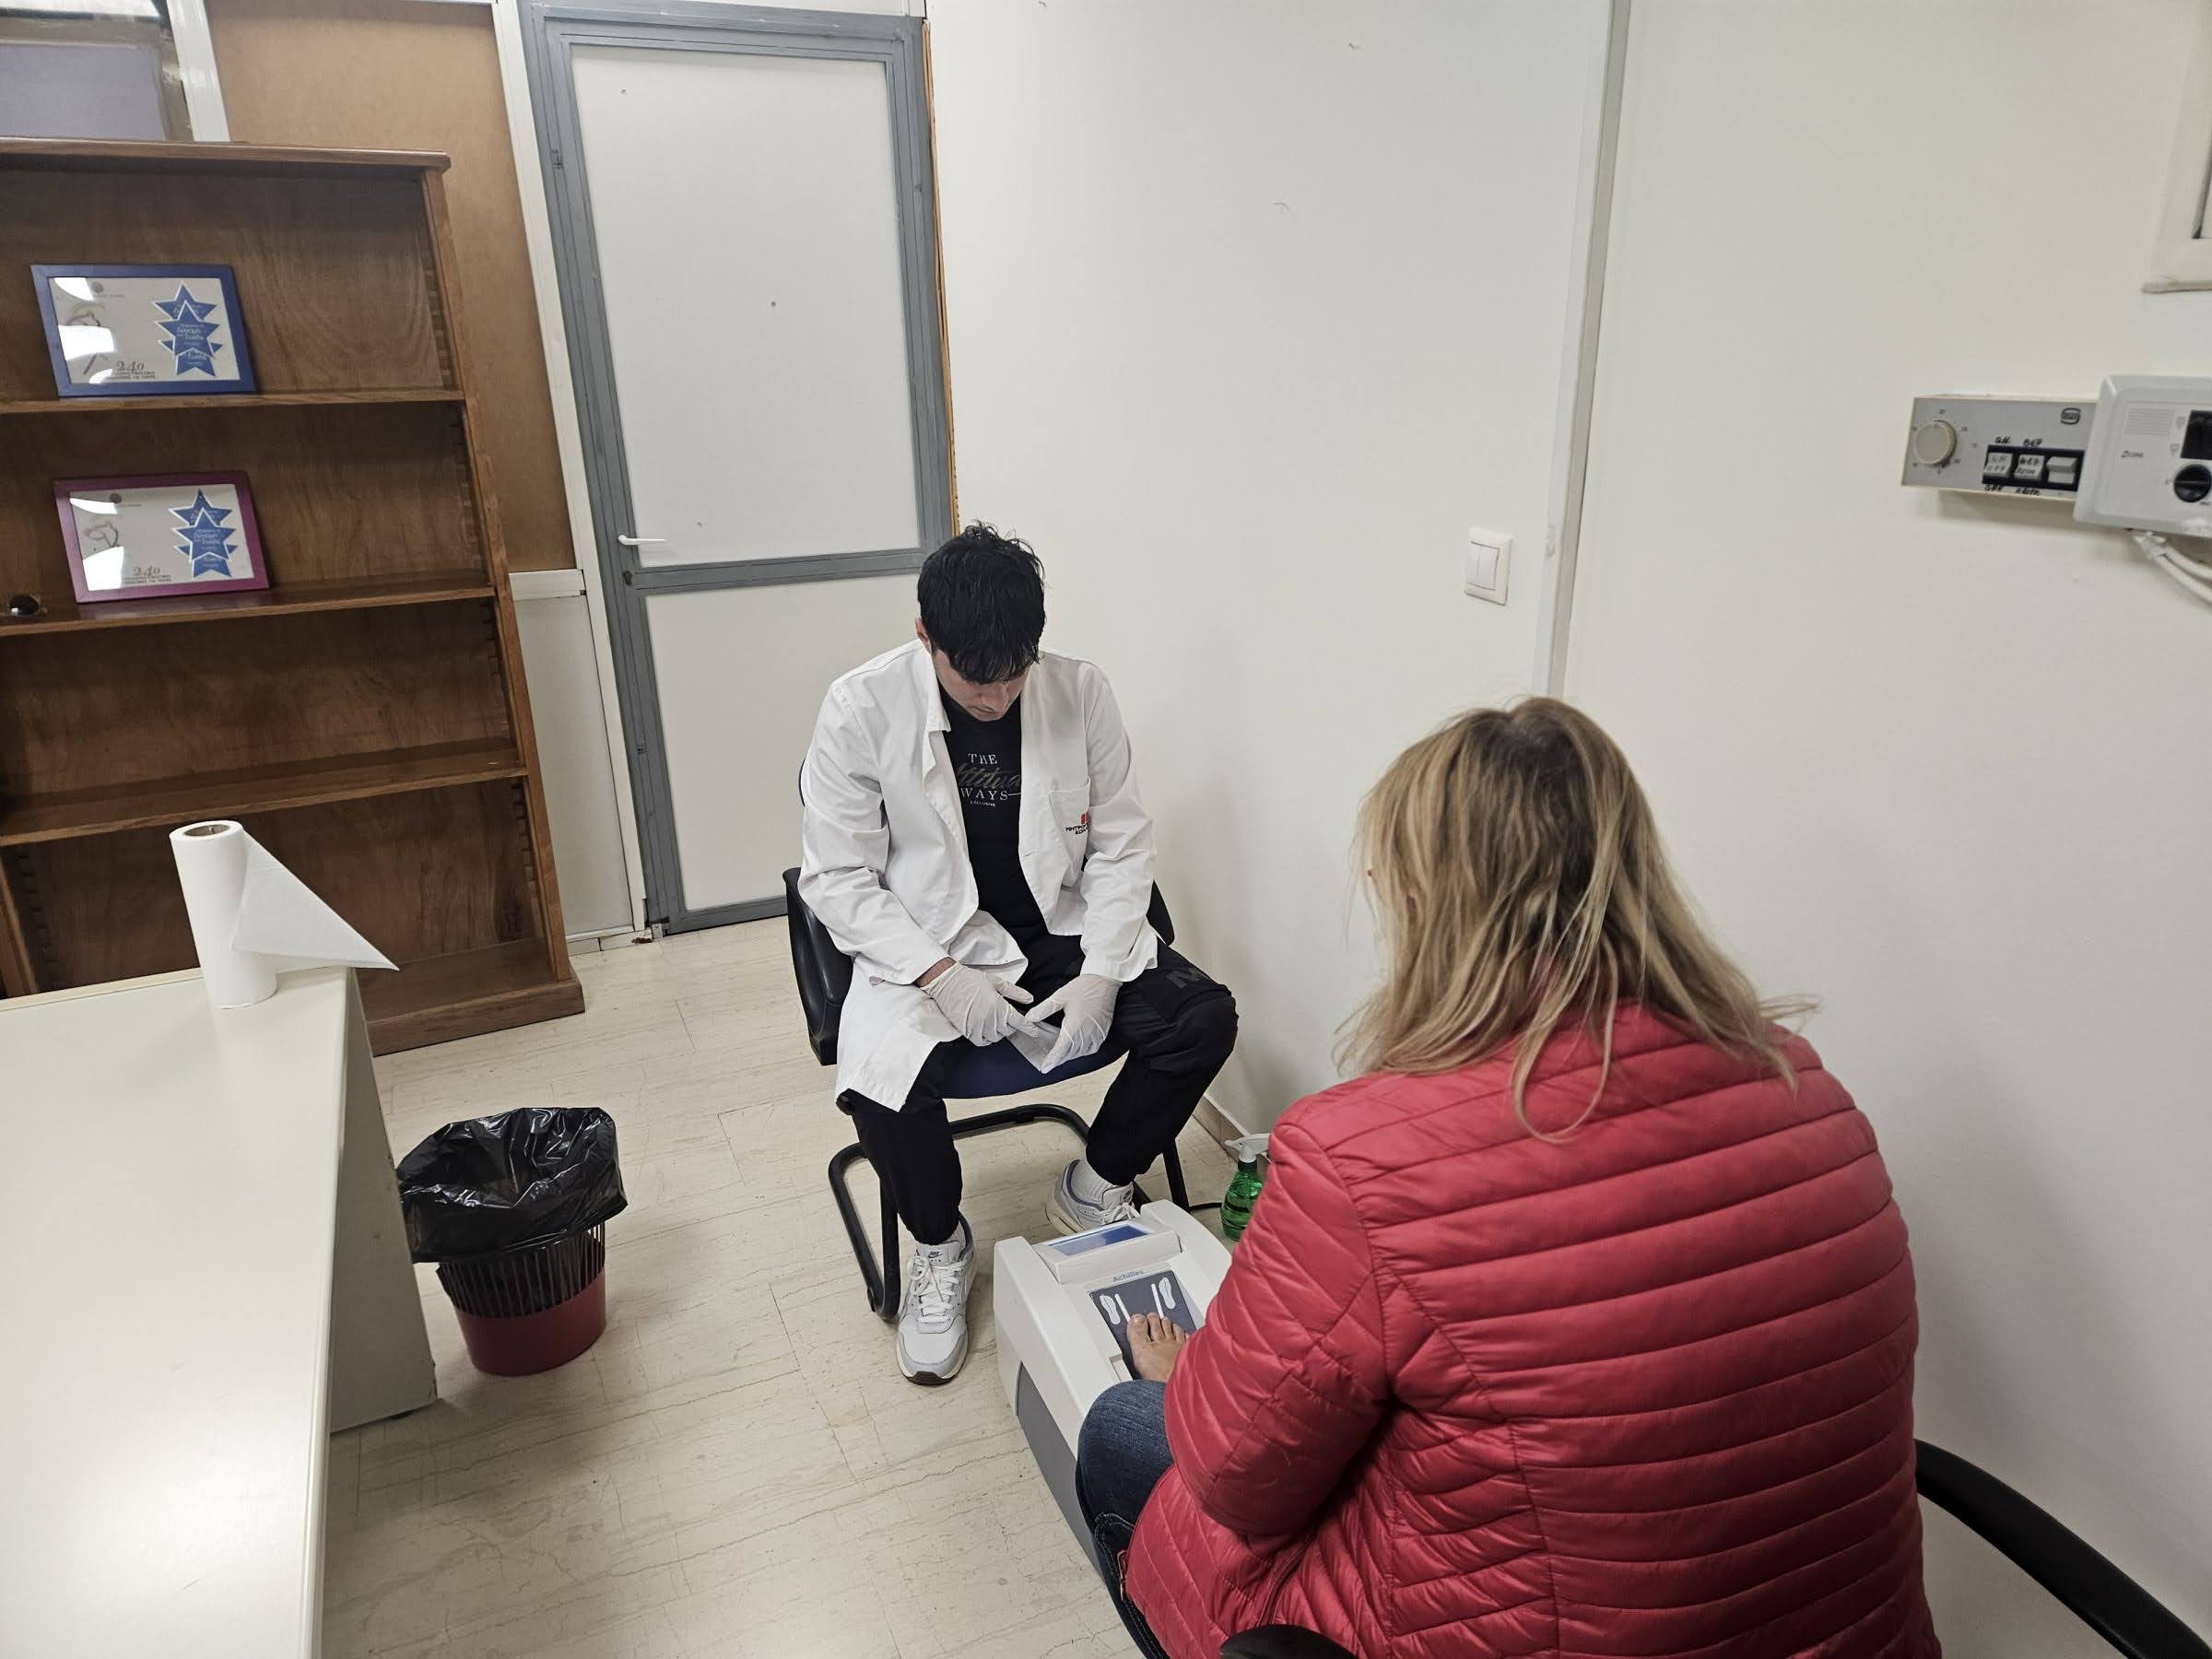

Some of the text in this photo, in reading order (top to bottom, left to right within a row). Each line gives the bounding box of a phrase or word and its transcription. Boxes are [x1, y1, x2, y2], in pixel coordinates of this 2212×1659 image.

[968, 752, 998, 765] THE
[959, 787, 1009, 801] WAYS
[1112, 1269, 1145, 1282] Achilles
